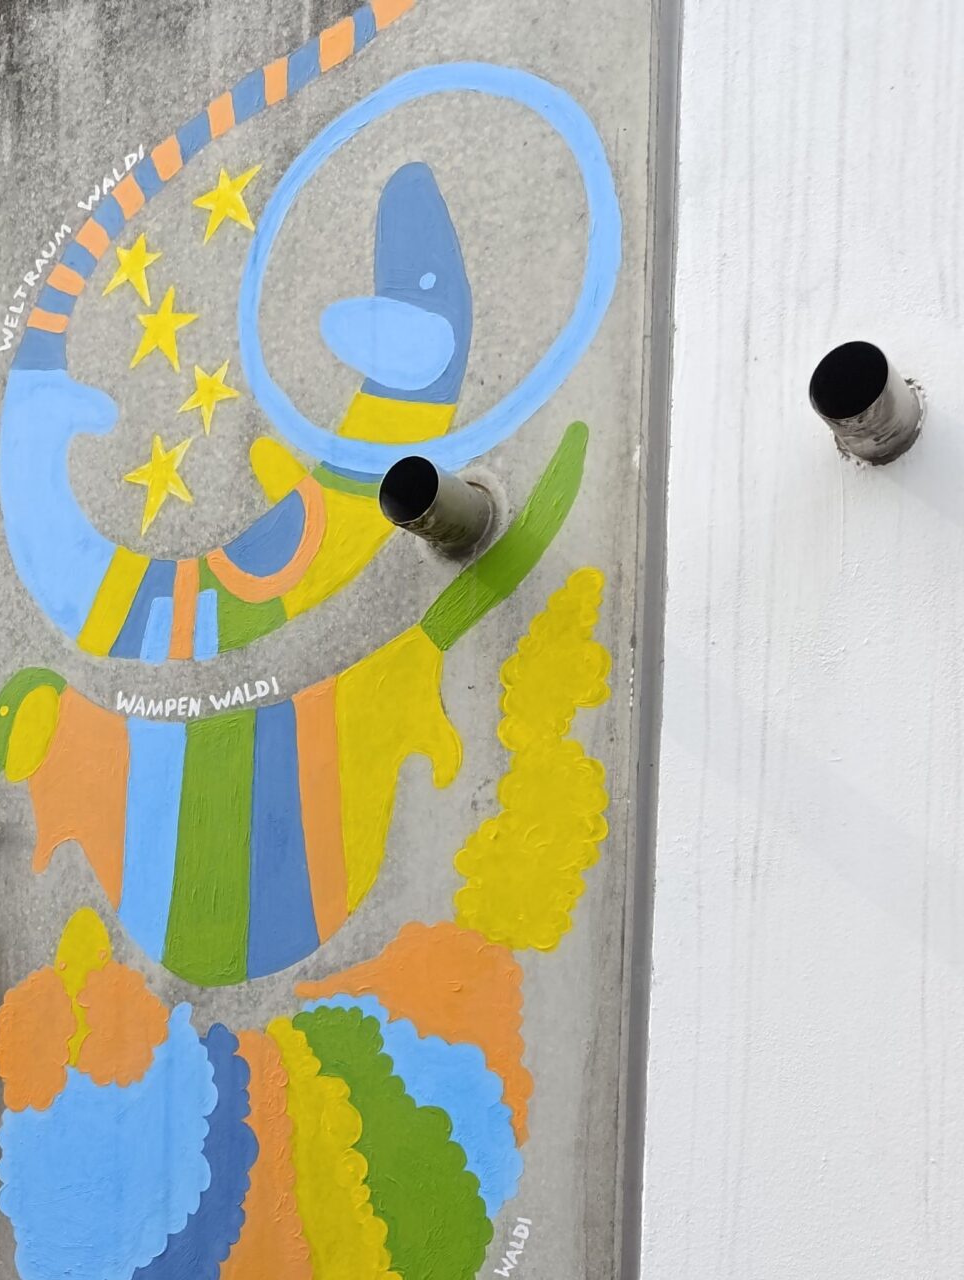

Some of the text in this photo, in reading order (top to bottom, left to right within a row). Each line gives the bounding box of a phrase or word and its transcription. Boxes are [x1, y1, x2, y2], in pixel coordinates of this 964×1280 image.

[77, 143, 145, 211] WALDI
[116, 676, 280, 717] WAMPEN WALDI
[493, 1216, 533, 1278] WALDI
